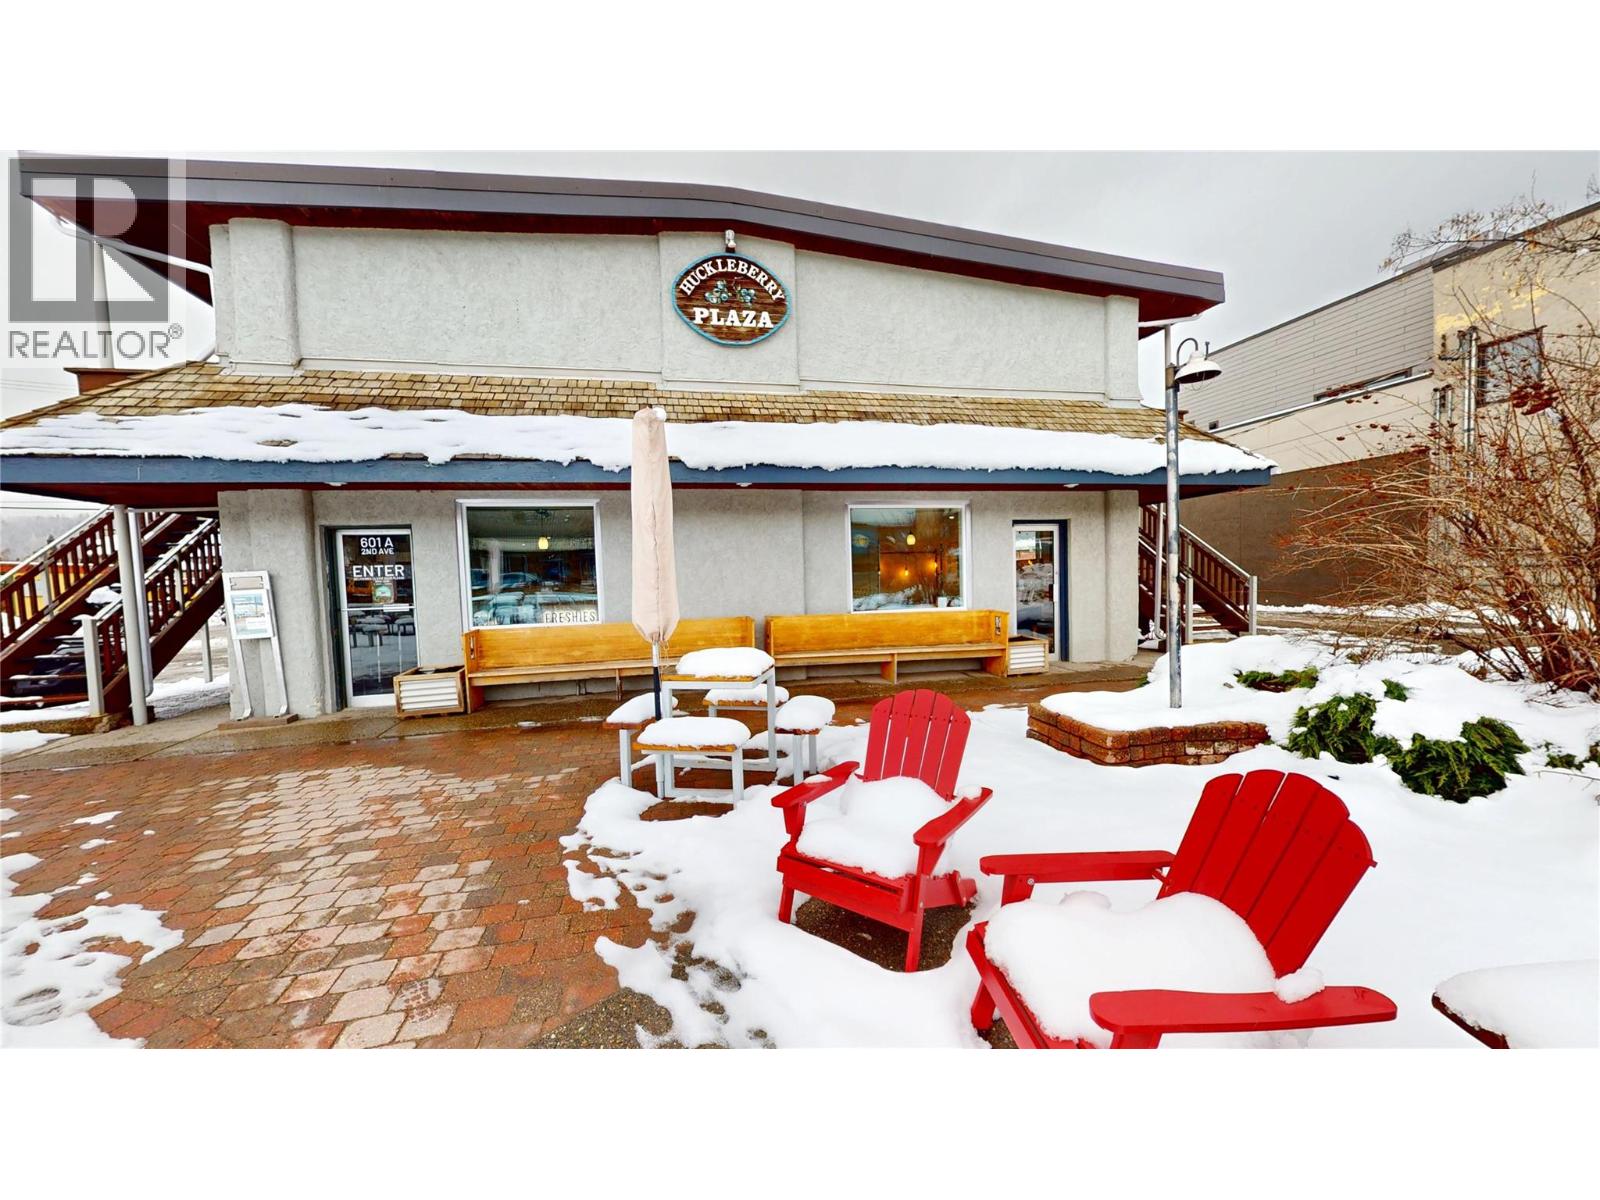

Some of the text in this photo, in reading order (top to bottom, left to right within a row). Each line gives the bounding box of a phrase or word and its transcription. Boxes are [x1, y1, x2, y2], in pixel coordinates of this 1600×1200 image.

[679, 258, 786, 301] HUCKLEBERRY
[692, 307, 774, 328] PLAZA
[360, 537, 394, 548] 601 A
[352, 565, 405, 577] ENTER
[545, 611, 597, 624] FRESHIES
